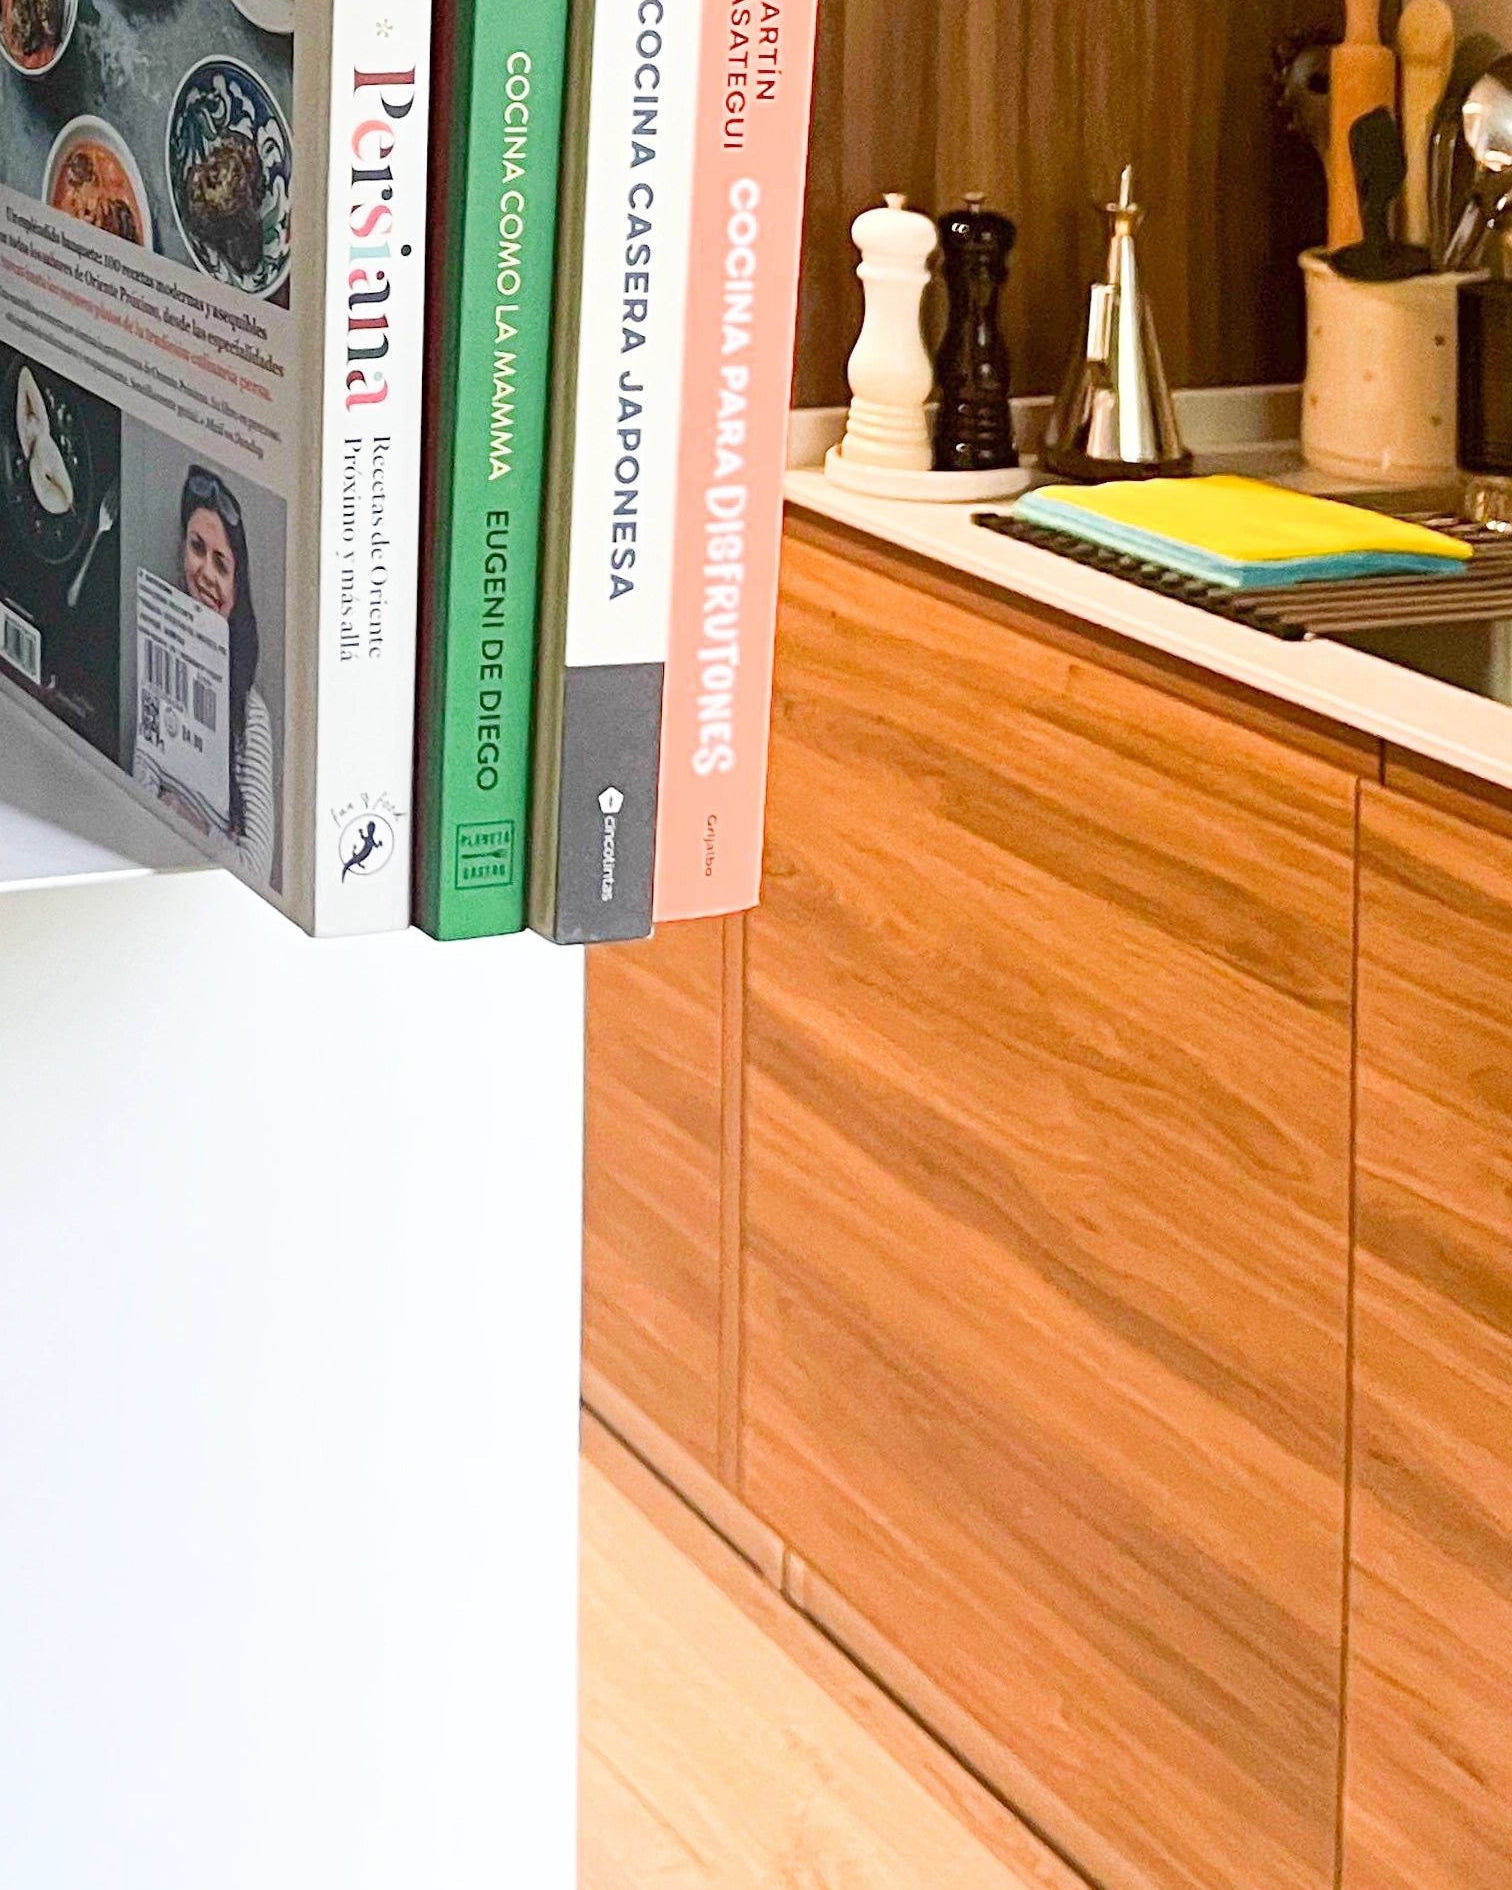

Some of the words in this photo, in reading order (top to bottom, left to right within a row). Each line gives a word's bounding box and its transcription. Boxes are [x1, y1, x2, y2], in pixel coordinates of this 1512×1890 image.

[500, 51, 531, 184] COCINA
[345, 63, 417, 412] Persiana
[496, 191, 526, 296] COMO
[620, 184, 655, 356] CASERA
[720, 178, 760, 356] COCINA
[494, 306, 516, 345] LA
[487, 351, 519, 481] MAMMA
[713, 366, 750, 477] PARA
[343, 438, 363, 542] Próximo
[371, 436, 391, 527] Recetas
[609, 370, 646, 600] JAPONESA
[335, 550, 355, 563] y
[341, 569, 360, 616] más
[371, 531, 390, 560] de
[481, 510, 509, 628] EUGENI
[340, 621, 360, 662] allá
[368, 565, 388, 659] Oriente
[480, 640, 505, 680] DE
[692, 484, 749, 776] DISFRUTONES
[477, 690, 503, 791] DIEGO
[601, 816, 617, 902] cincotintas
[704, 815, 717, 877] Grijalbo
